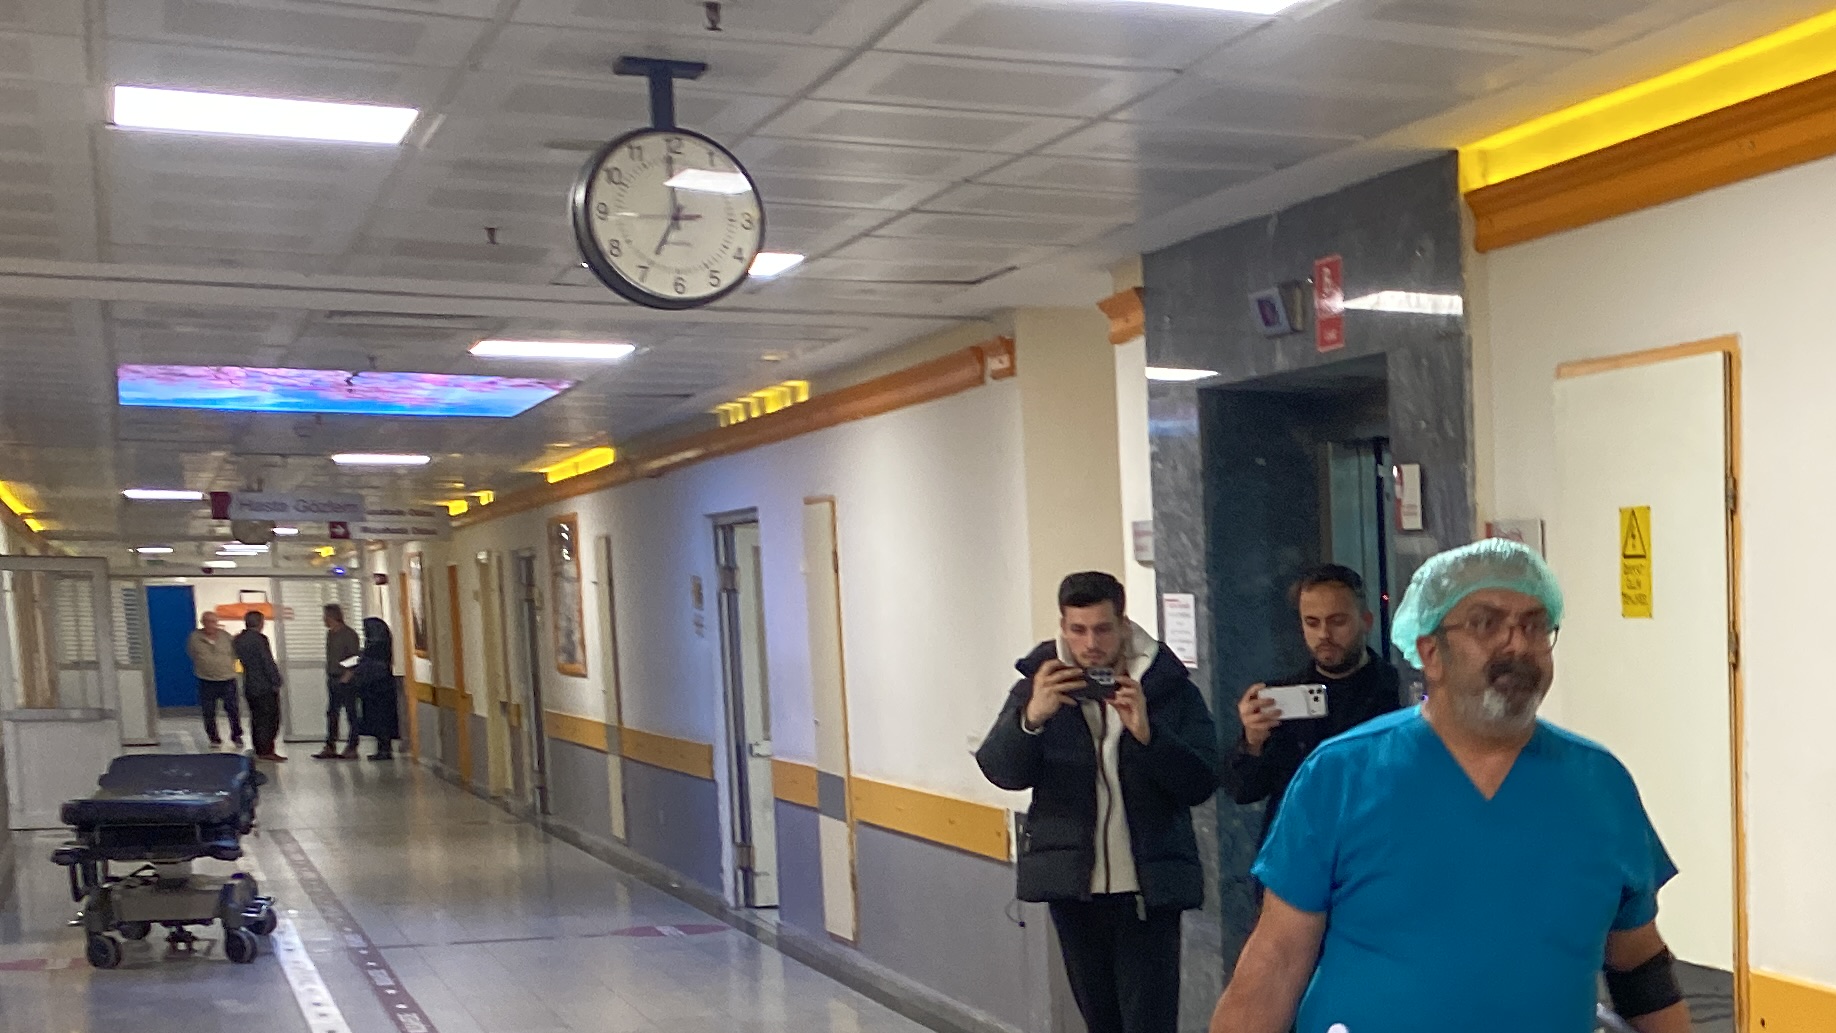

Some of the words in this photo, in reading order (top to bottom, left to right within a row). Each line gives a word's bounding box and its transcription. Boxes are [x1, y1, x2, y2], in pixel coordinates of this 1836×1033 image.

[664, 136, 684, 155] 12
[597, 202, 609, 221] 9
[741, 212, 754, 231] 3
[609, 238, 622, 257] 8
[637, 265, 649, 283] 7
[708, 270, 721, 288] 5
[674, 276, 687, 295] 6
